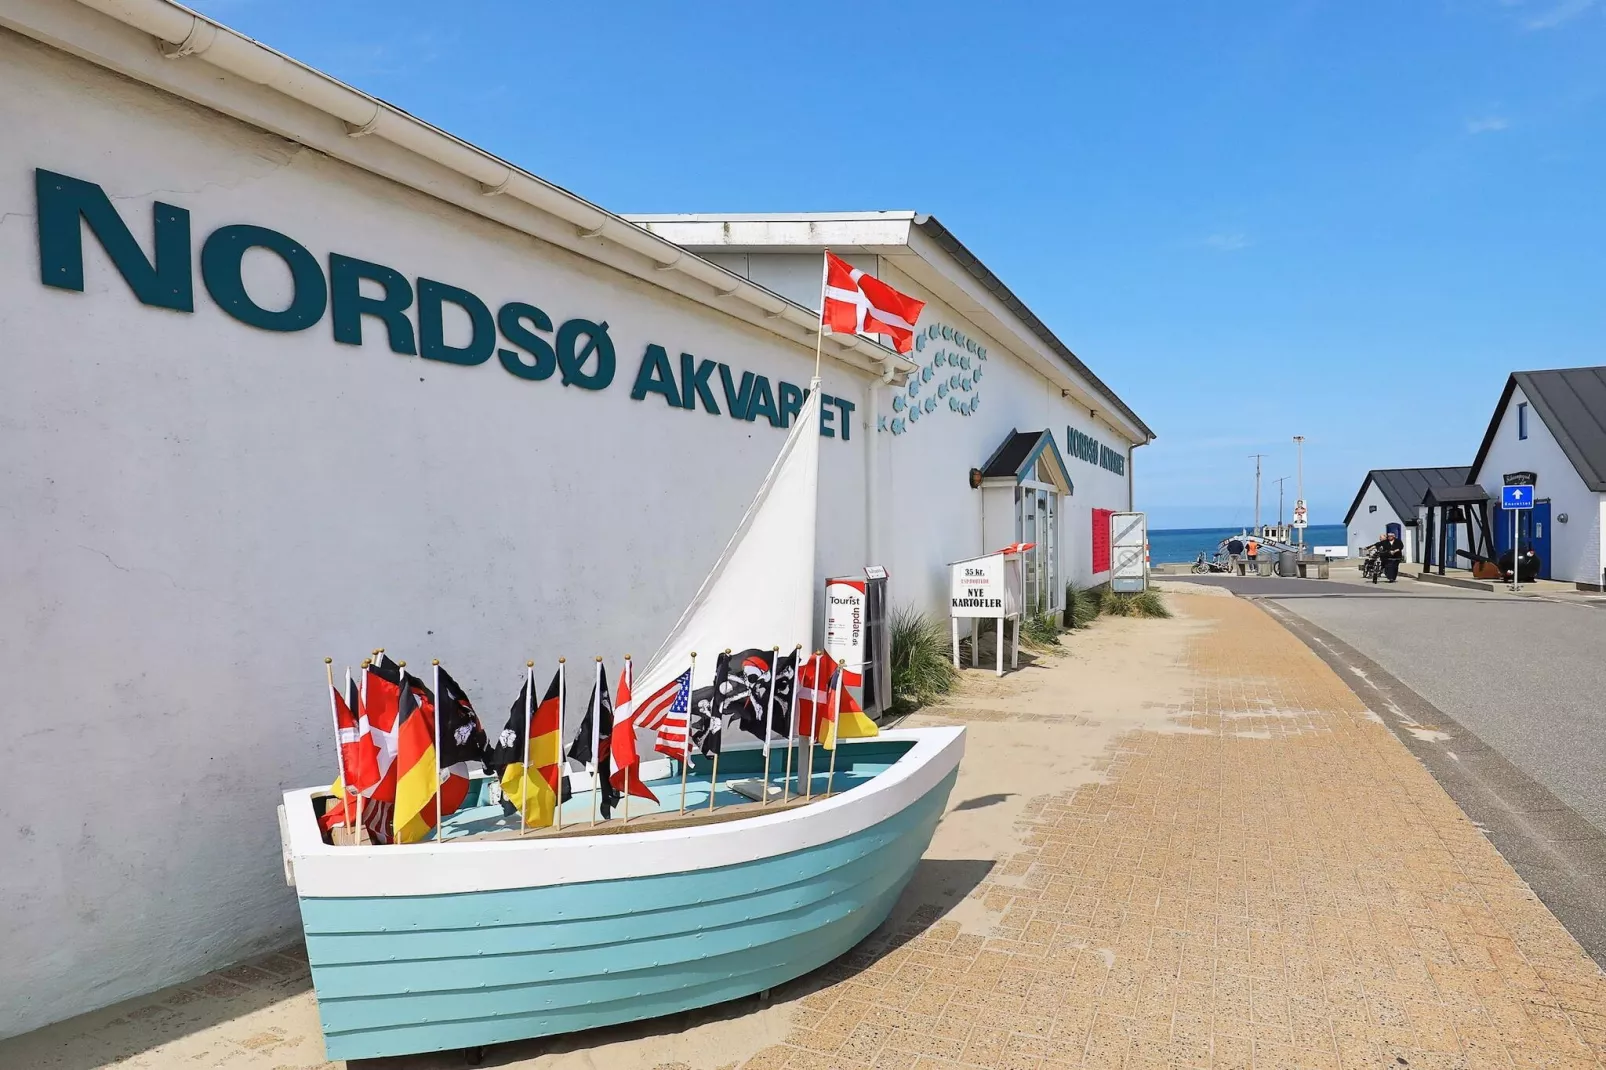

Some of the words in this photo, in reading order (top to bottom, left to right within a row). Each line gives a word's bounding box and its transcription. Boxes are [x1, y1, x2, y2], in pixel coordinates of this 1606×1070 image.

[36, 168, 616, 390] NORDSØ
[630, 343, 855, 440] AKVARET
[1067, 425, 1099, 465] NORDSØ
[968, 588, 984, 597] NYE
[829, 596, 860, 605] Tourist
[952, 598, 1002, 607] KARTOFLER
